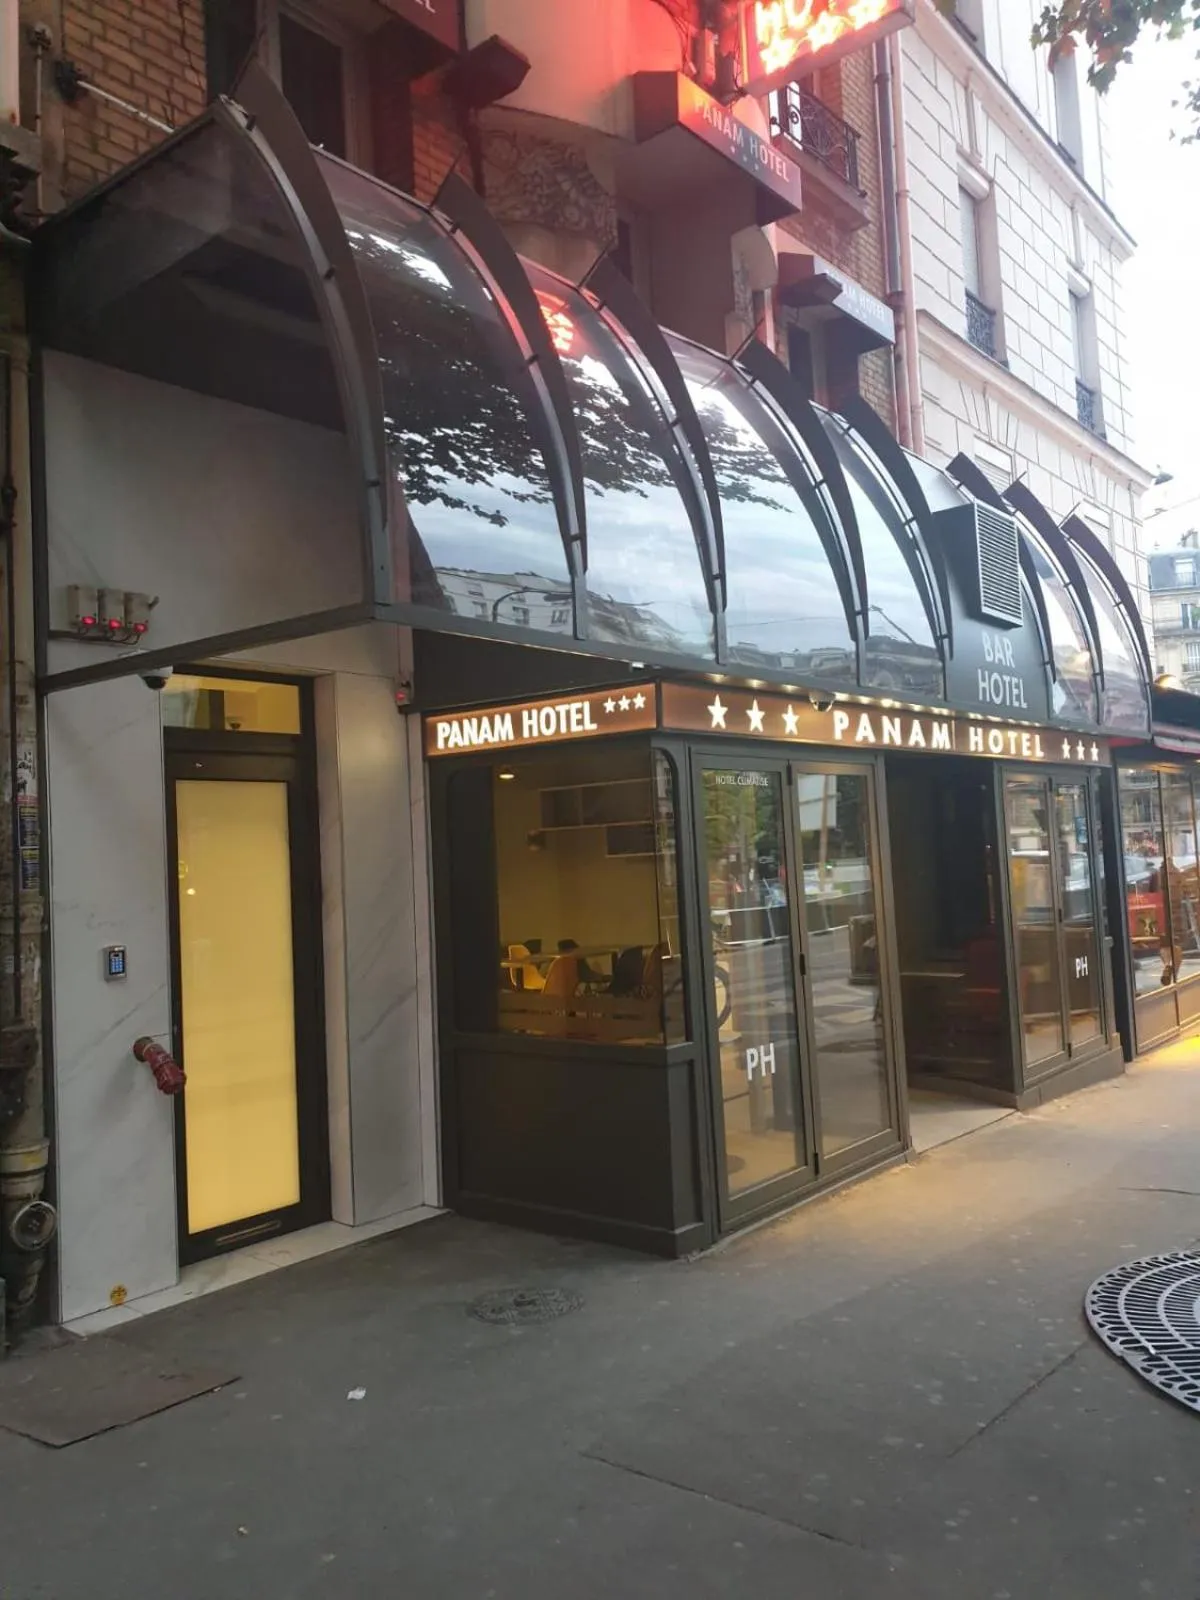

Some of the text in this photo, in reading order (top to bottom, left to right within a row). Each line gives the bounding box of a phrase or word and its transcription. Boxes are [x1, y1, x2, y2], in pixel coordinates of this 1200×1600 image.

[694, 97, 790, 183] PANAM HOTEL
[981, 629, 1016, 669] BAR
[977, 668, 1028, 709] HOTEL
[436, 701, 598, 750] PANAM HOTEL
[833, 710, 1045, 759] PANAM HOTEL
[715, 775, 736, 785] HOTEL
[1075, 955, 1089, 979] PH
[746, 1042, 776, 1081] PH
